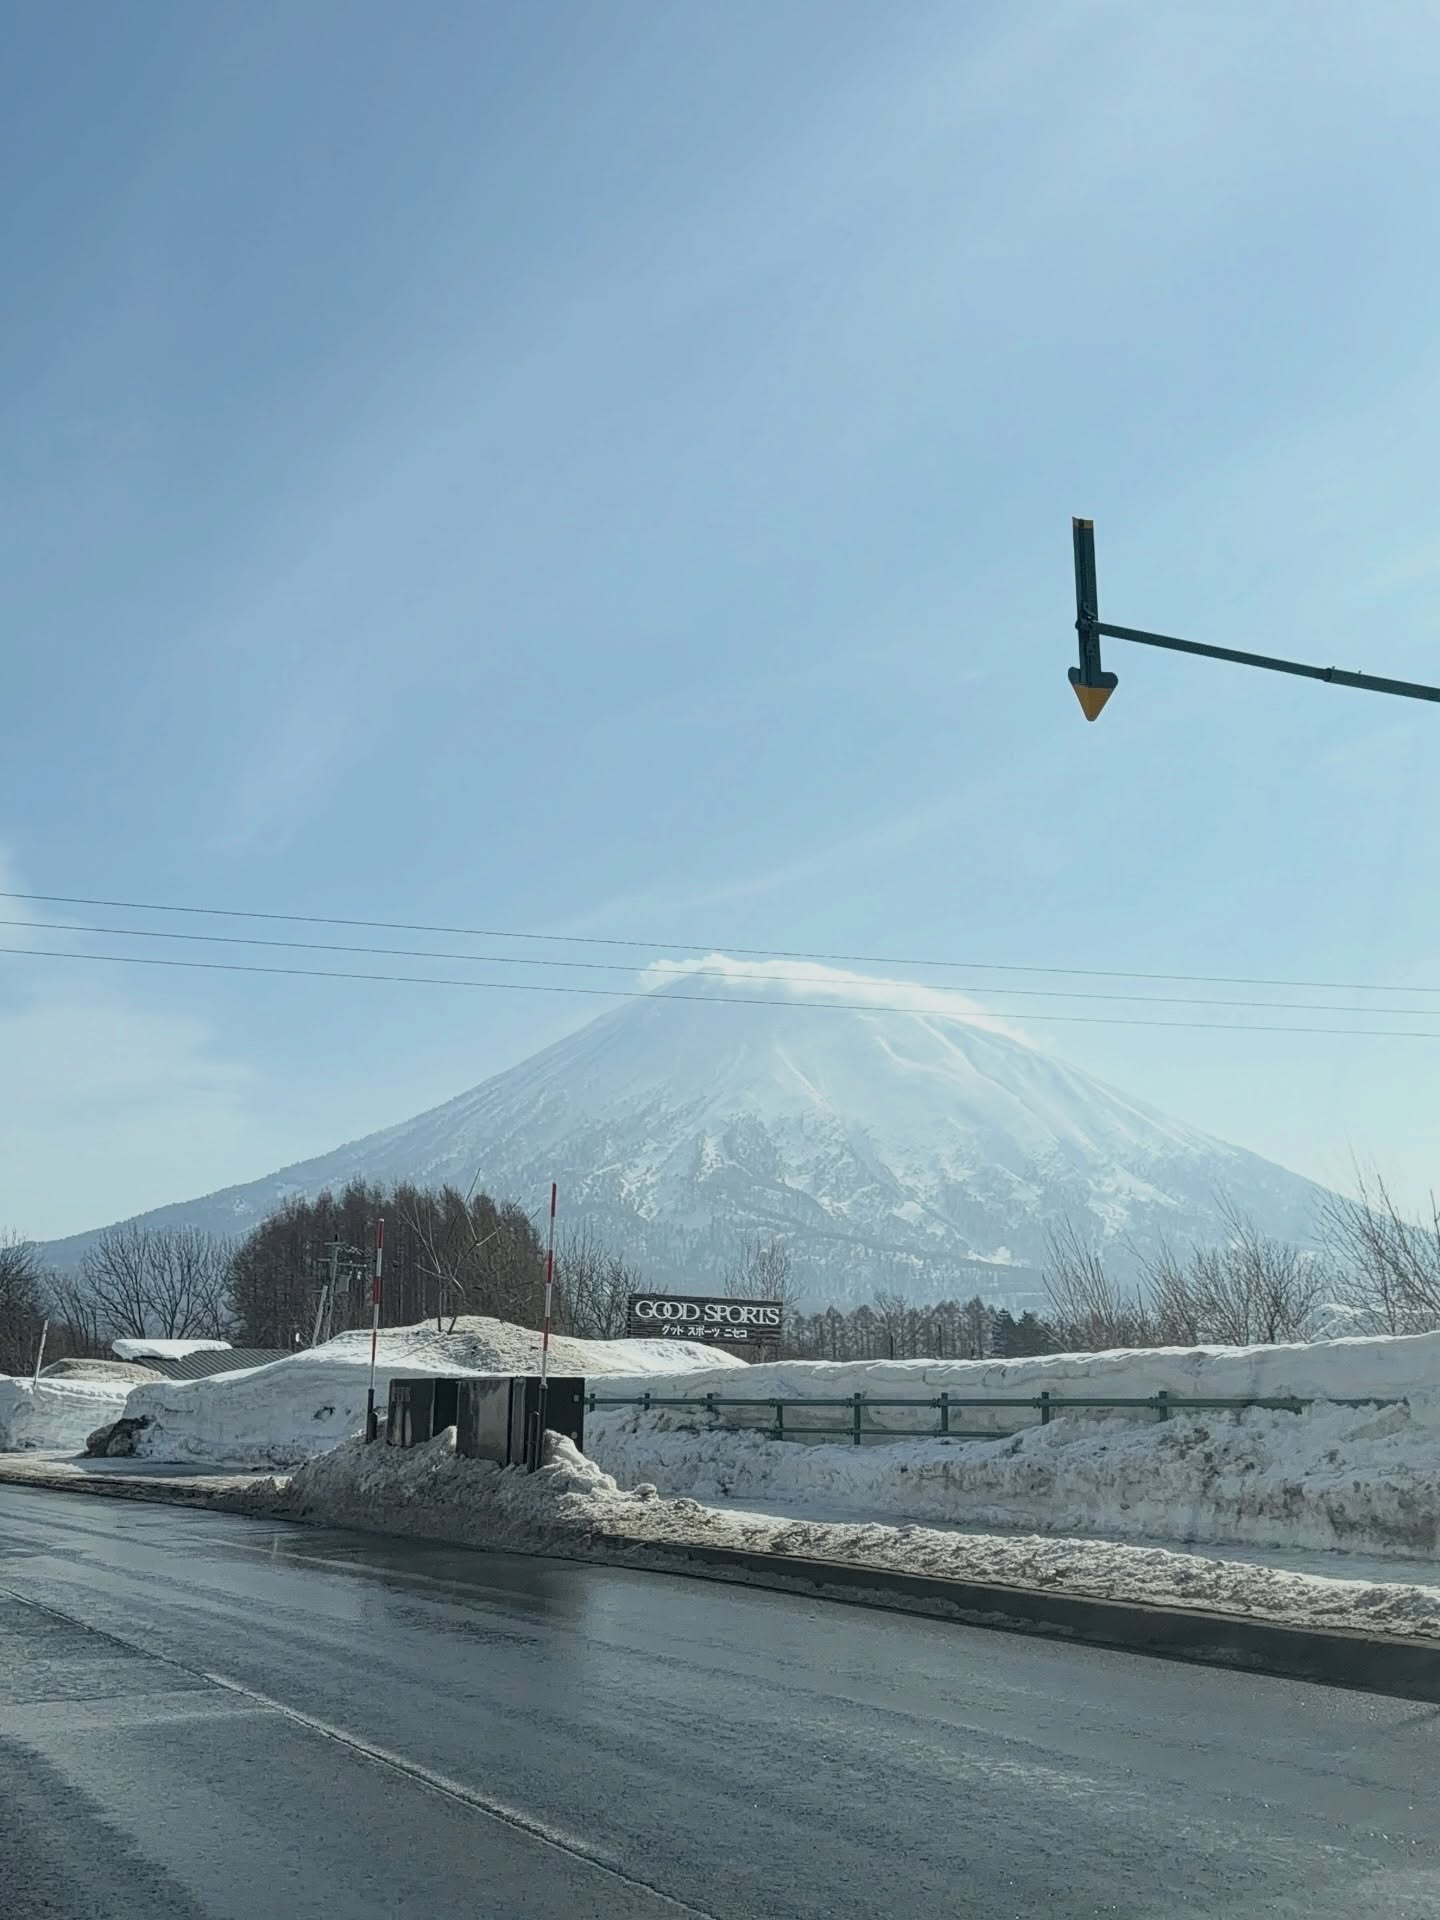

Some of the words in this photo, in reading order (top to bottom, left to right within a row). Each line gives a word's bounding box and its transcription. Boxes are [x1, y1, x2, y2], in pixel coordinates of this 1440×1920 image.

[635, 1300, 700, 1320] GOOD
[704, 1304, 780, 1325] SPORTS
[688, 1325, 720, 1338] スポーツ
[724, 1328, 747, 1339] ニセコ
